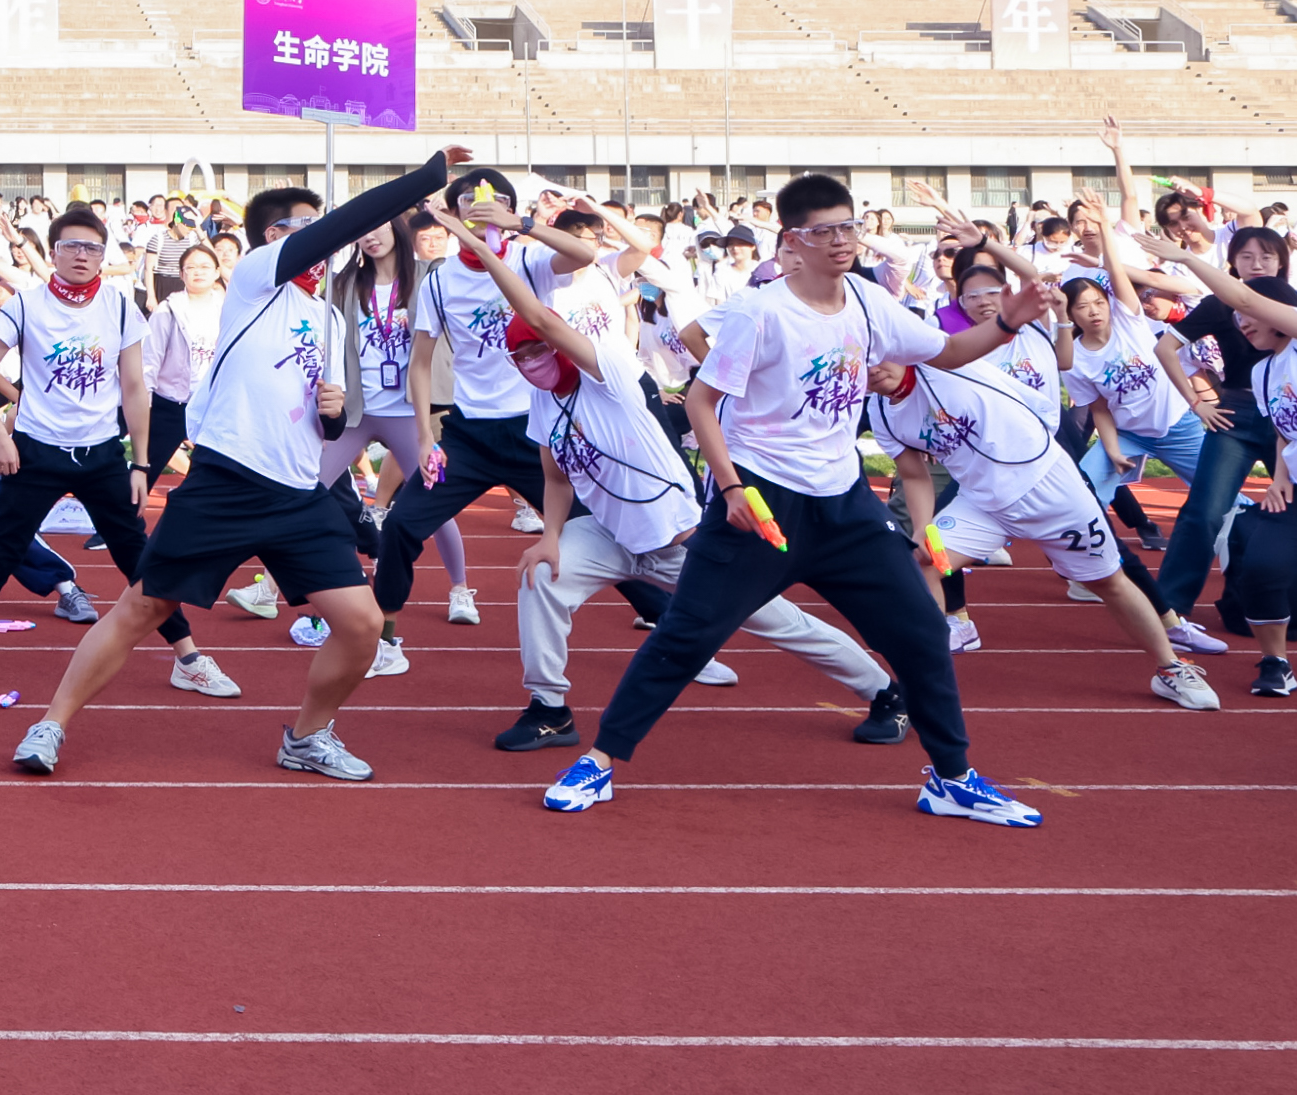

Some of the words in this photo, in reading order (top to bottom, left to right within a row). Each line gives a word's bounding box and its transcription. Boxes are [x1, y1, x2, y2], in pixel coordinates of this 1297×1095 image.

[273, 30, 389, 77] 生命学院
[43, 336, 106, 370] 无体育
[798, 346, 862, 388] 无体育
[43, 363, 107, 402] 不清华
[790, 380, 863, 430] 不清华
[1059, 517, 1106, 551] 25
